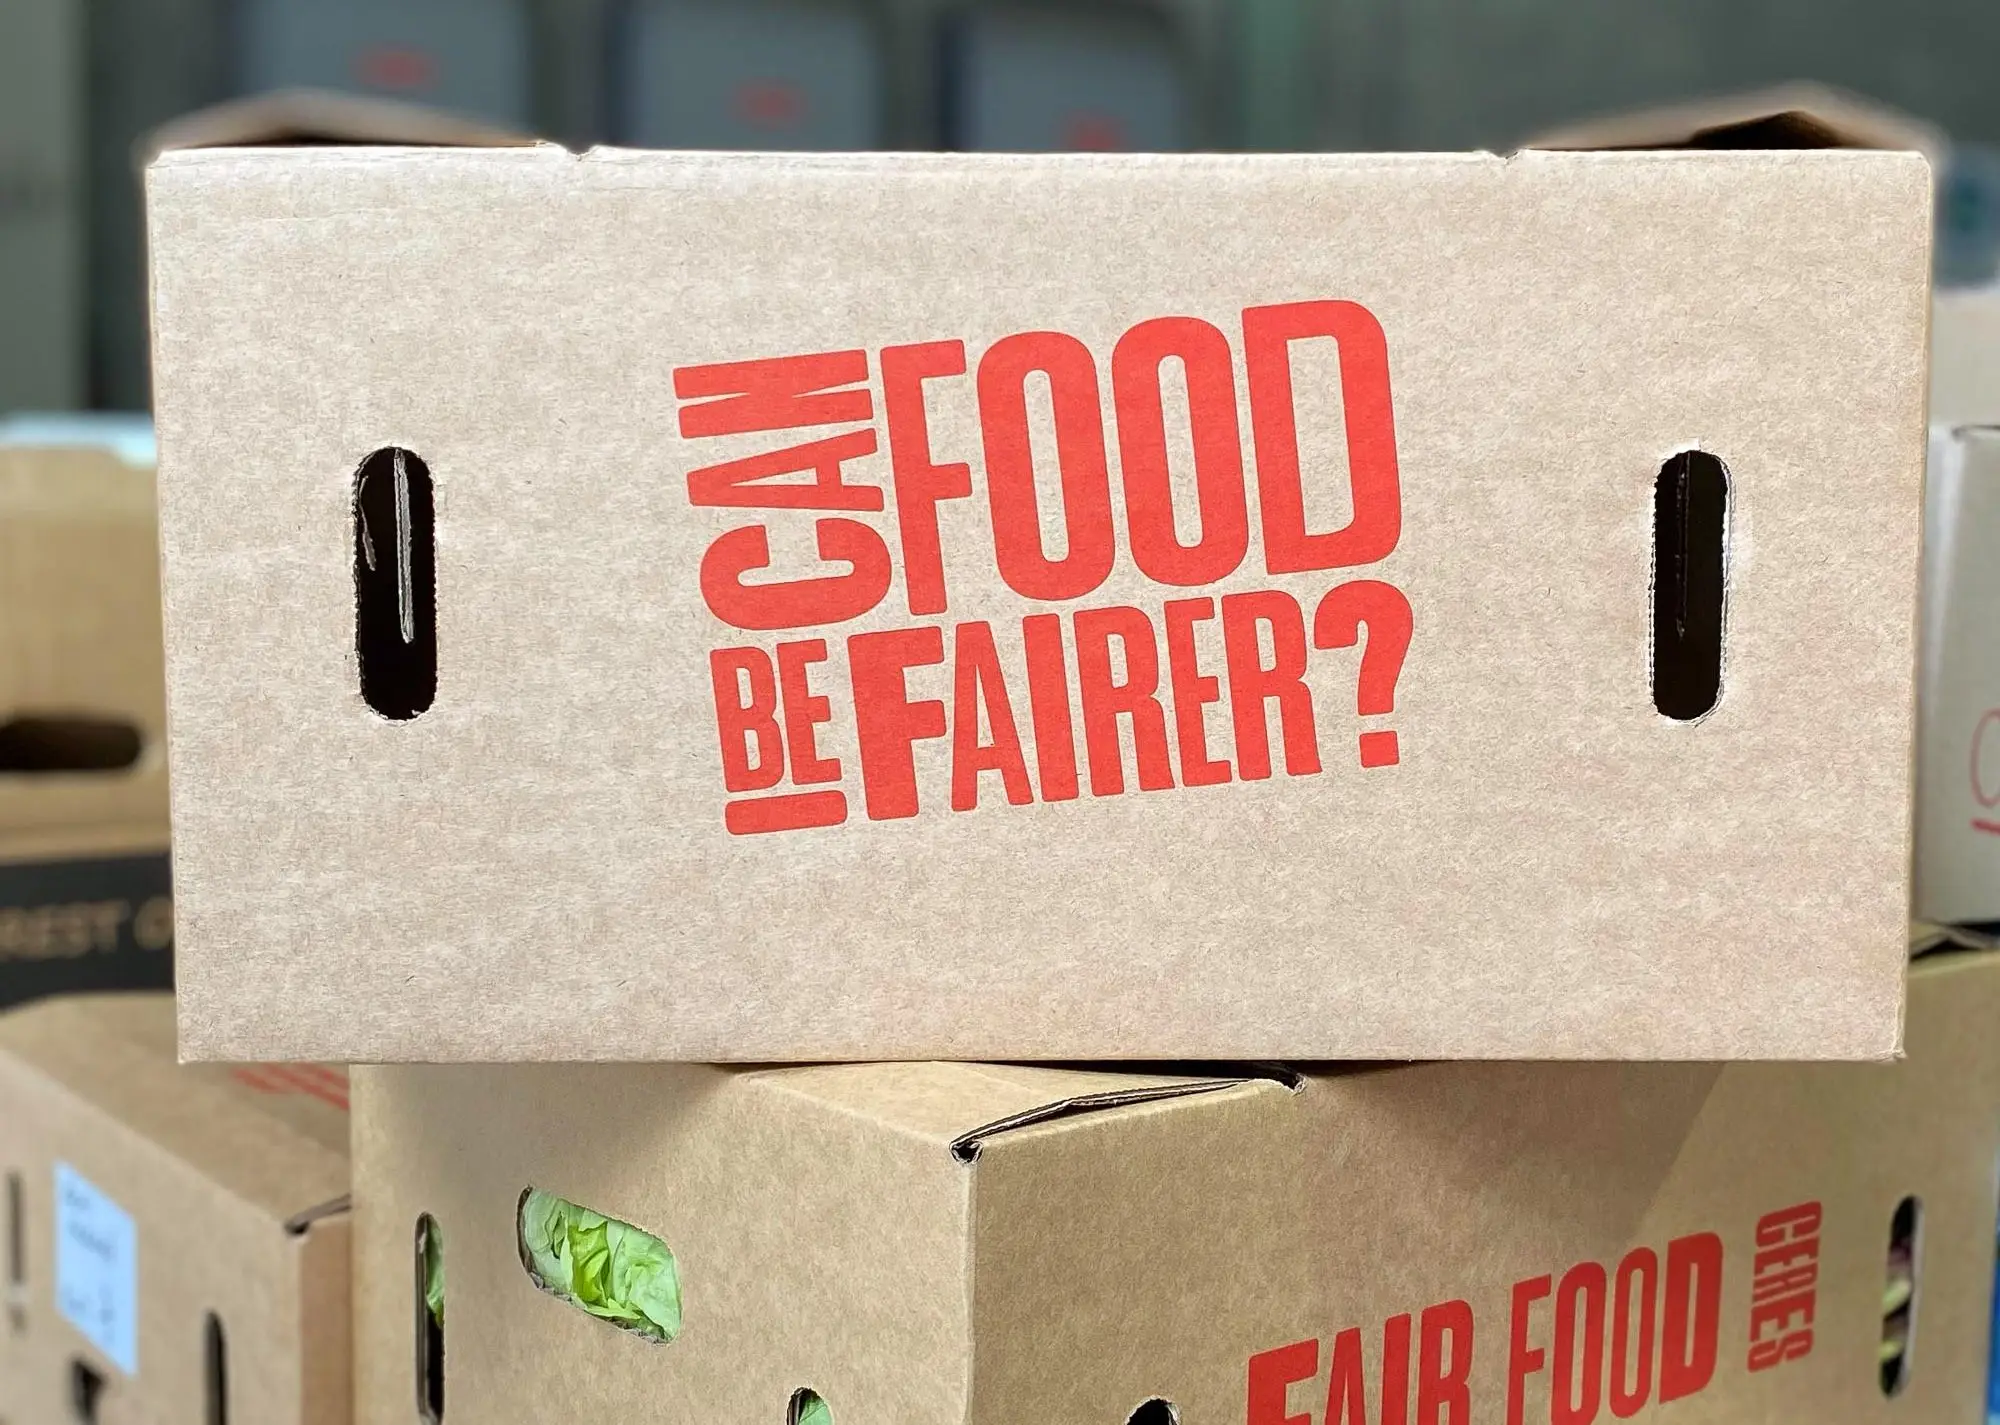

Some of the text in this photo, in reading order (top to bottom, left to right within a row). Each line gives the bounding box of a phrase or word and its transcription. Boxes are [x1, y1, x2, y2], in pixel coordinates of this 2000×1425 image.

[673, 349, 891, 631] CAN
[880, 300, 1401, 615] FOOD
[710, 580, 1413, 820] BE FAIRER?
[1507, 1234, 1722, 1425] FOOD
